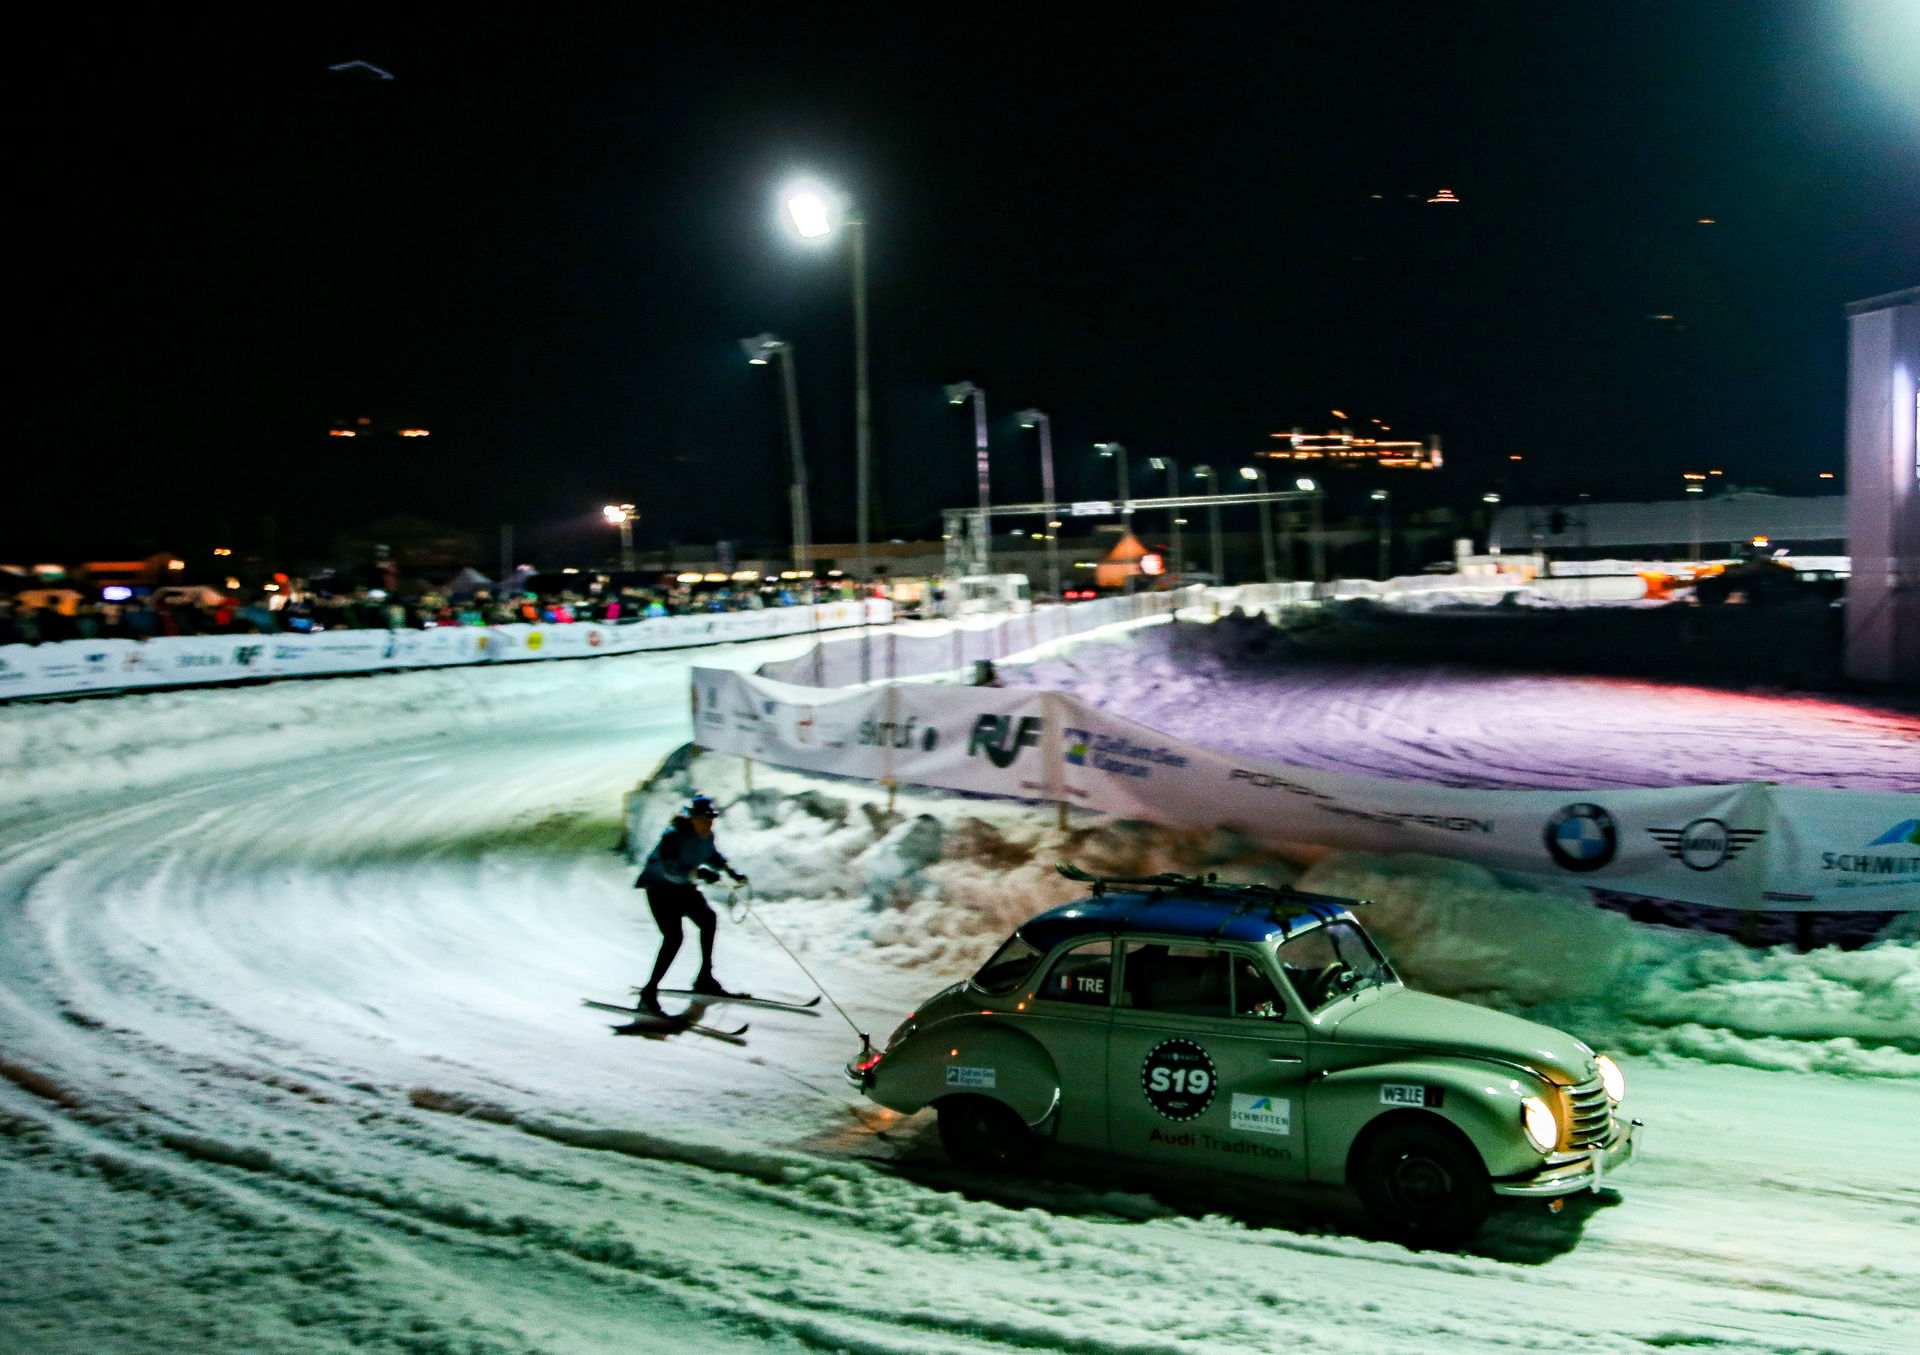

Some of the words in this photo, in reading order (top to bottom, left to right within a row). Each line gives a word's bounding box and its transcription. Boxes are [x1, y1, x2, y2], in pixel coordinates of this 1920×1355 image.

[968, 714, 1043, 768] RUF
[1076, 977, 1105, 994] TRE
[1148, 1066, 1210, 1096] S19
[1150, 1128, 1195, 1147] Audi
[1200, 1134, 1293, 1160] Tradition
